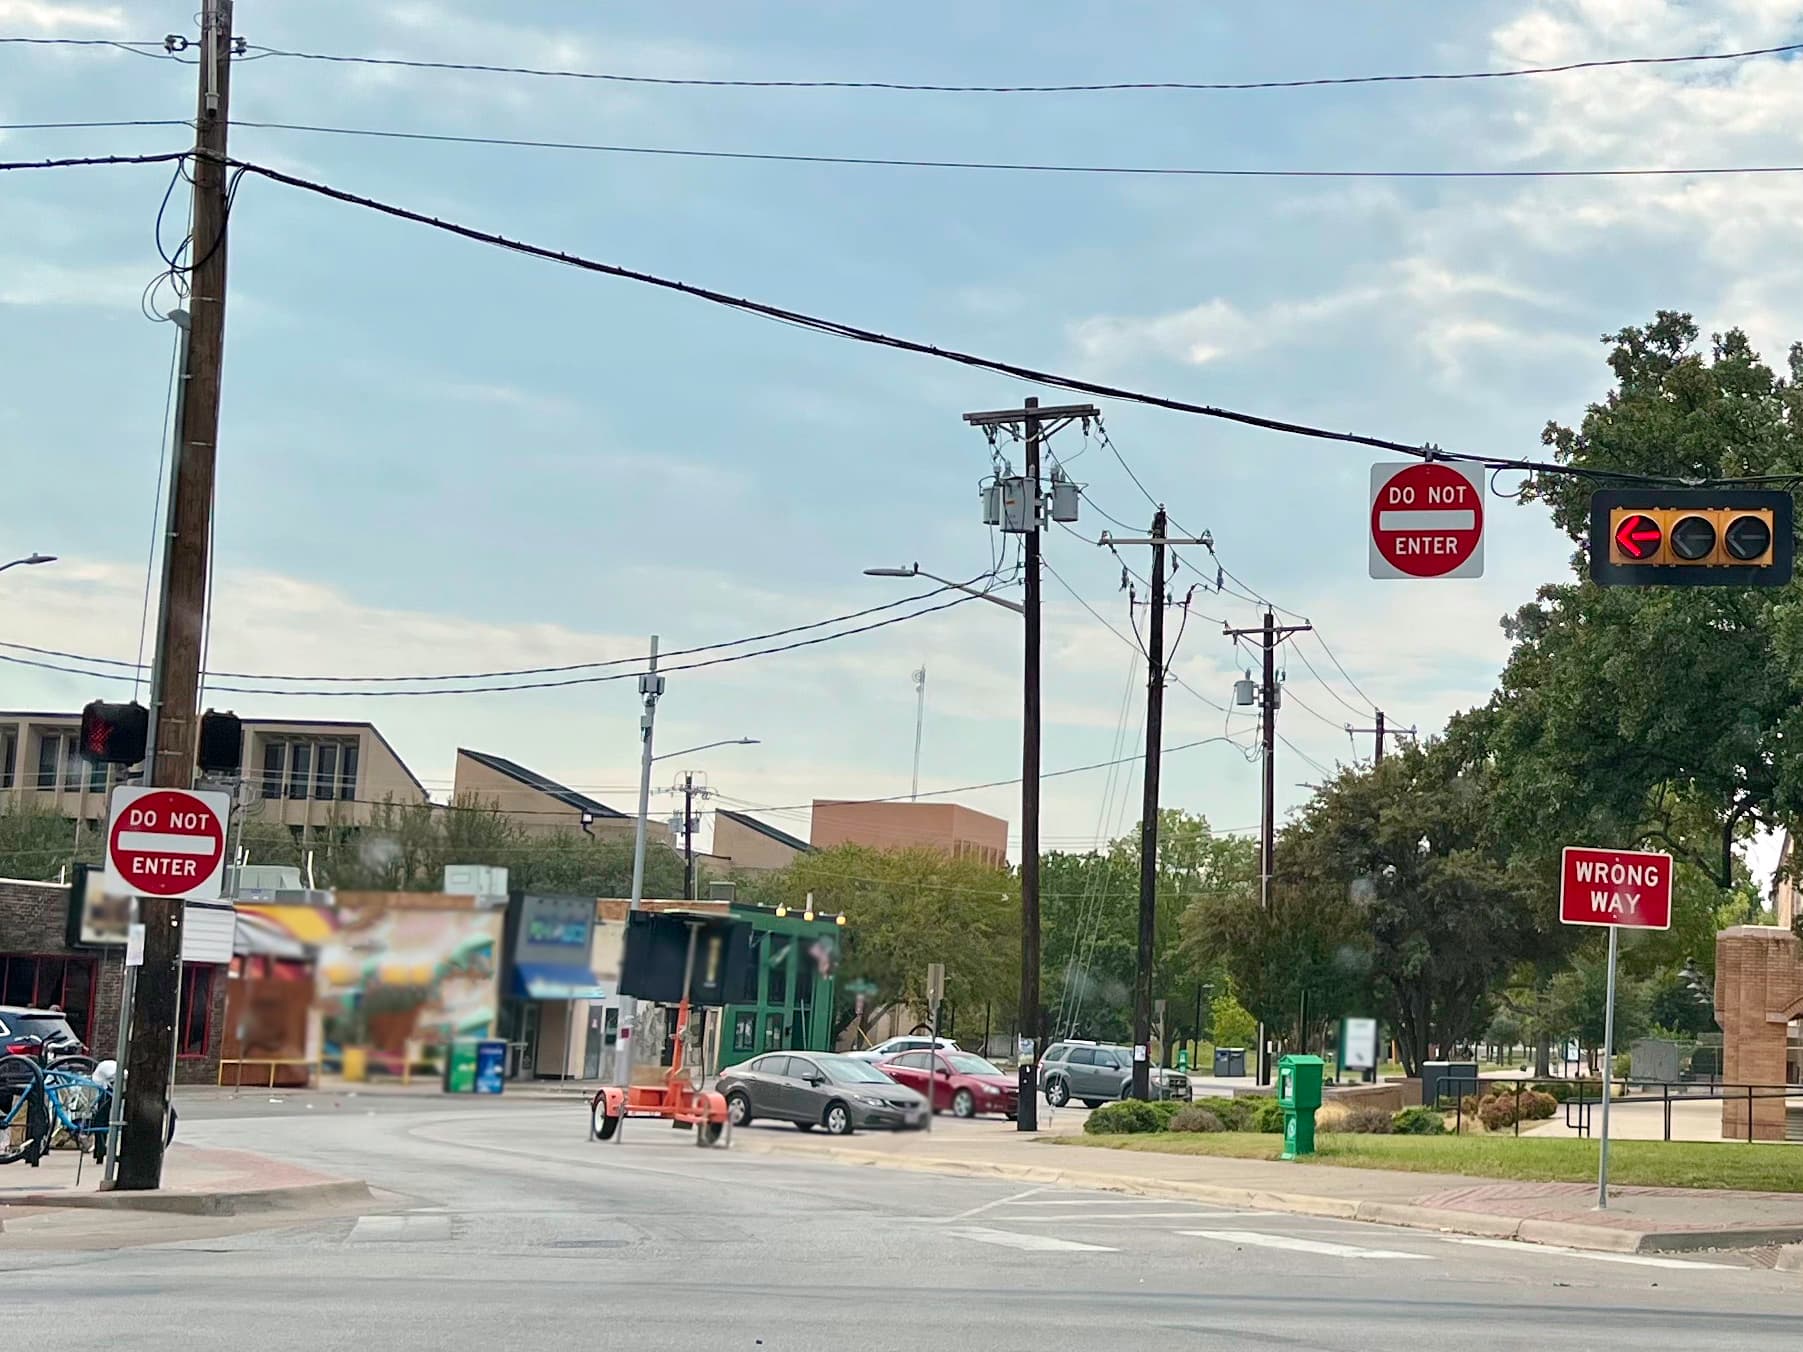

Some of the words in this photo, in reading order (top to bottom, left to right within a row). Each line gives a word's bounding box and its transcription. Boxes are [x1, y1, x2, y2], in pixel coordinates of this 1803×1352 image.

[1389, 487, 1415, 504] DO
[1428, 486, 1467, 504] NOT
[1395, 537, 1458, 555] ENTER
[130, 809, 157, 827] DO
[170, 812, 210, 831] NOT
[132, 856, 197, 877] ENTER
[1575, 861, 1659, 887] WRONG
[1590, 890, 1641, 915] WAY
